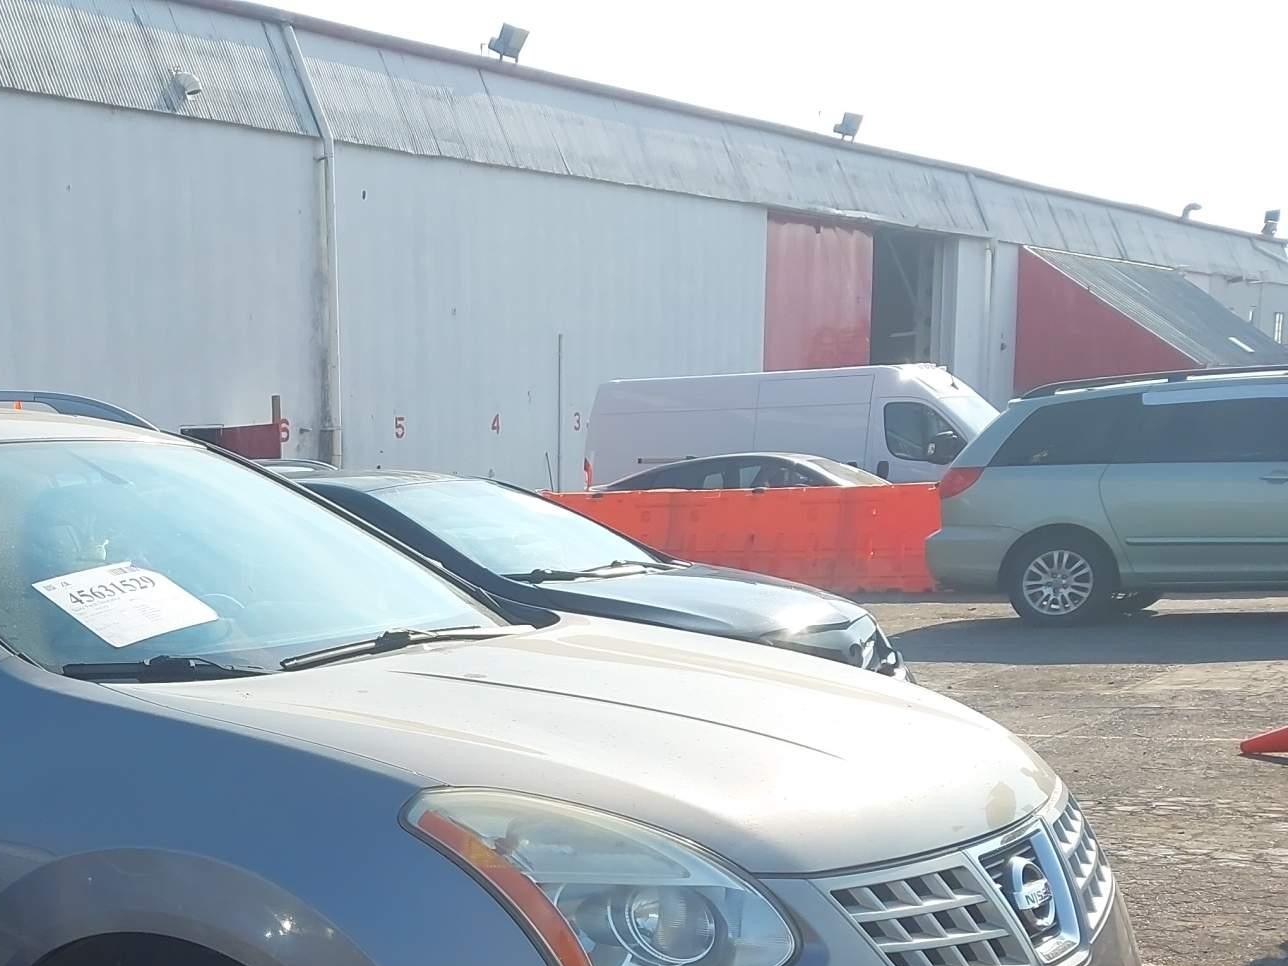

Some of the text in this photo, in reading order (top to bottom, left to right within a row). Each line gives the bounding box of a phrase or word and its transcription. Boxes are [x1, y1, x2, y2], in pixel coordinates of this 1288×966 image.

[394, 416, 405, 439] 5
[491, 413, 500, 435] 4
[573, 412, 581, 431] 3
[69, 575, 156, 605] 45631529
